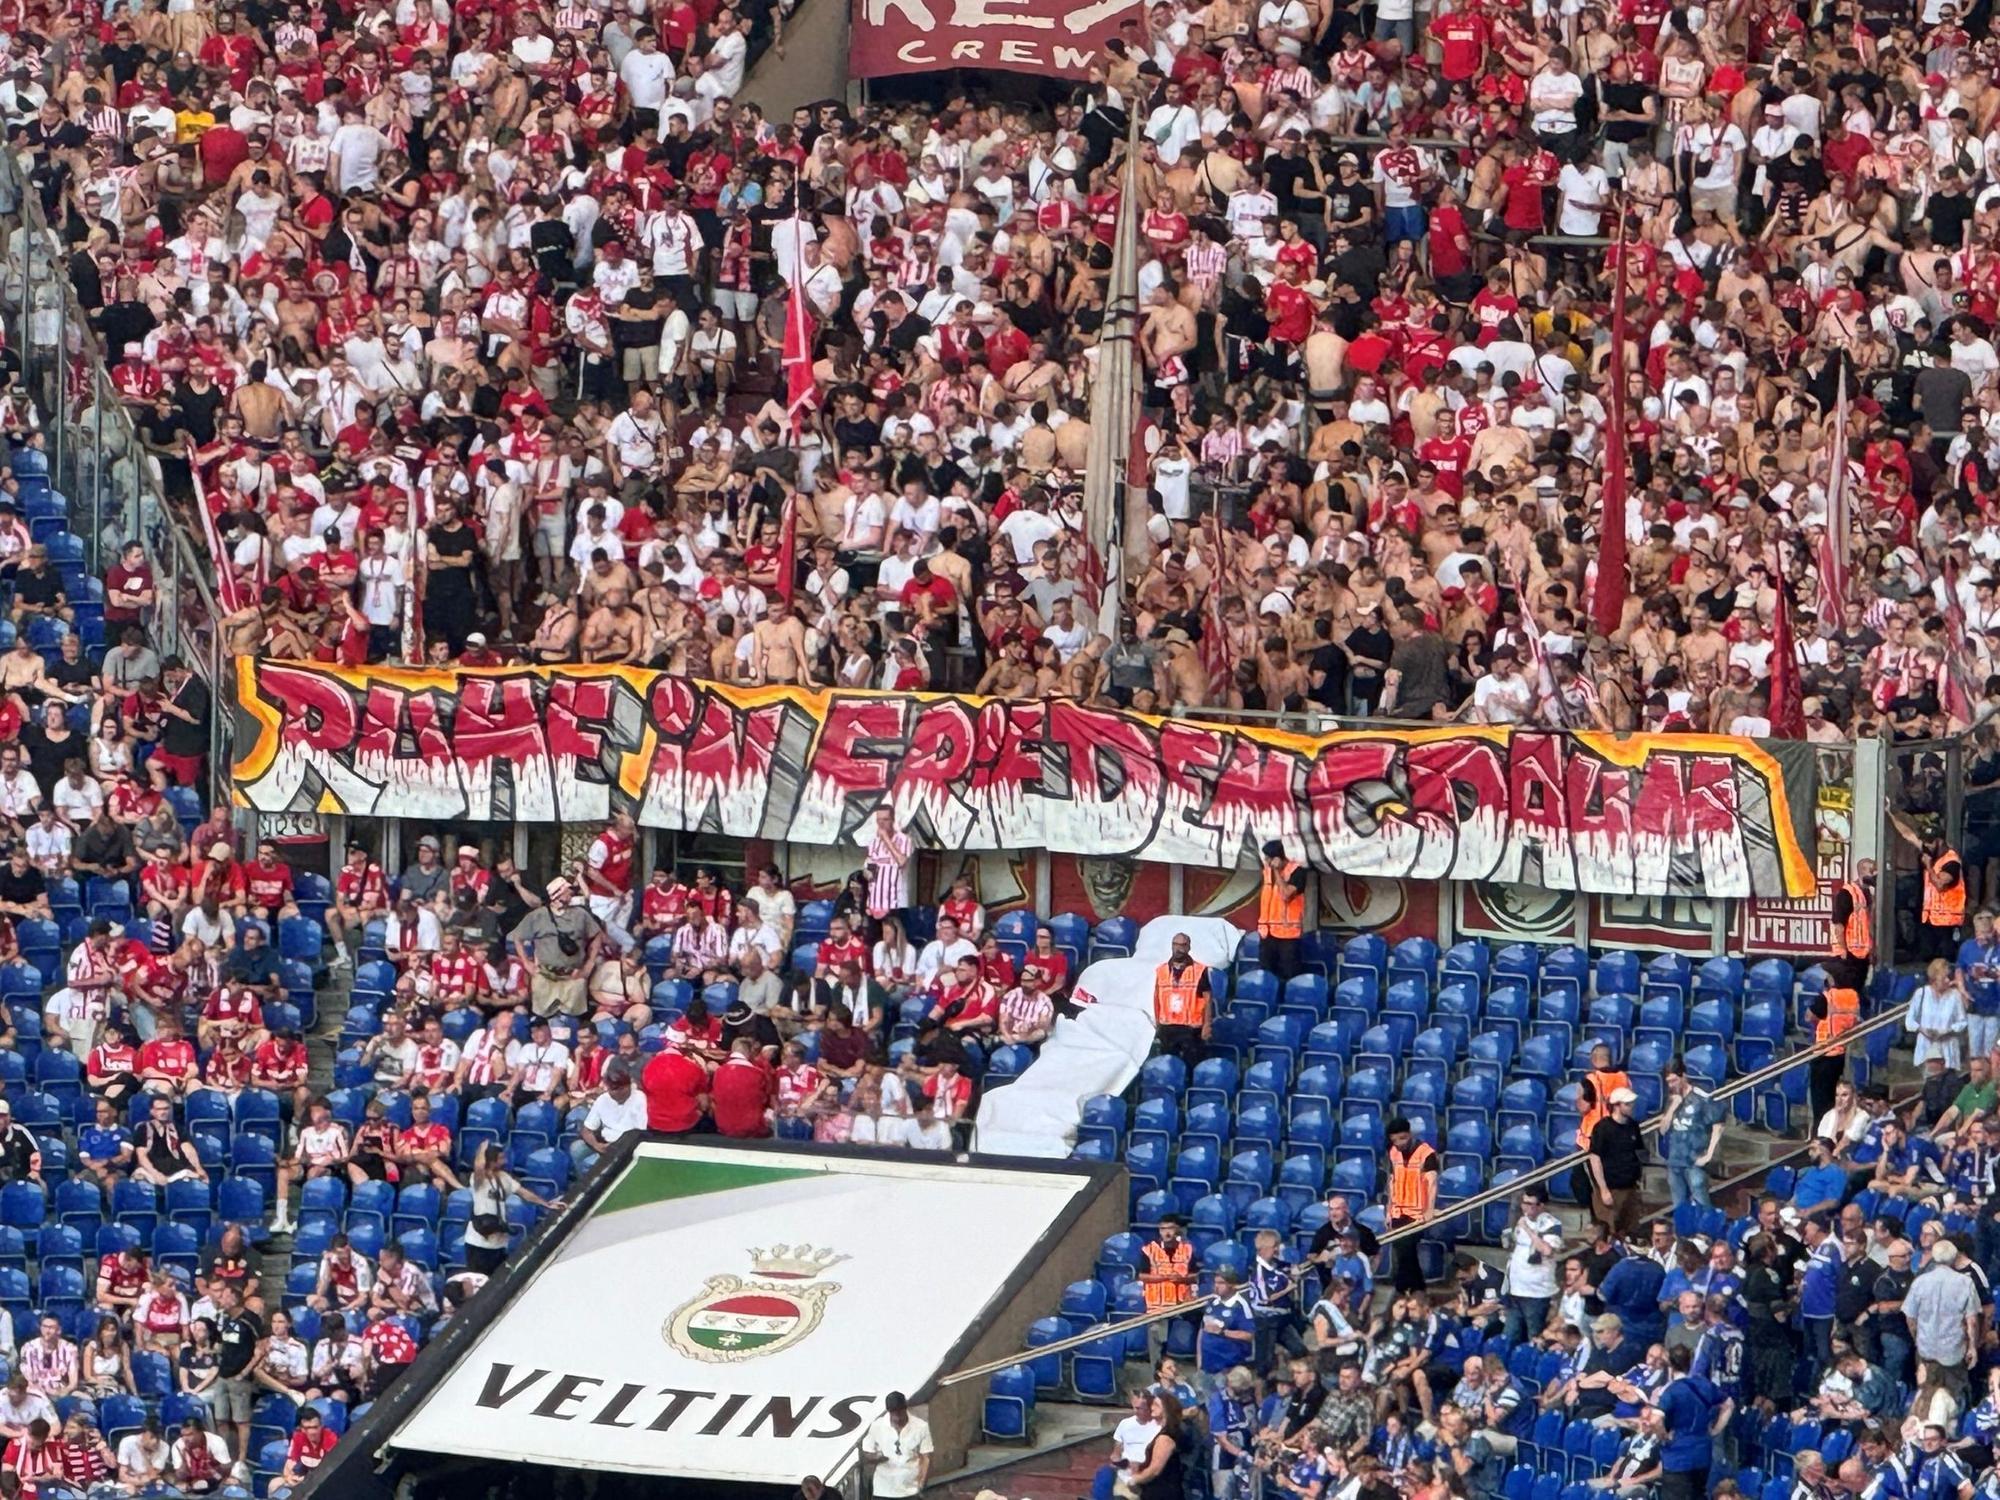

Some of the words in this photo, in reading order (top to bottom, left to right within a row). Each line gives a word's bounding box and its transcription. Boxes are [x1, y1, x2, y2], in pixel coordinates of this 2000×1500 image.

[896, 39, 1096, 69] CREW
[243, 657, 615, 823] RUHE
[474, 1362, 877, 1439] VELTINS
